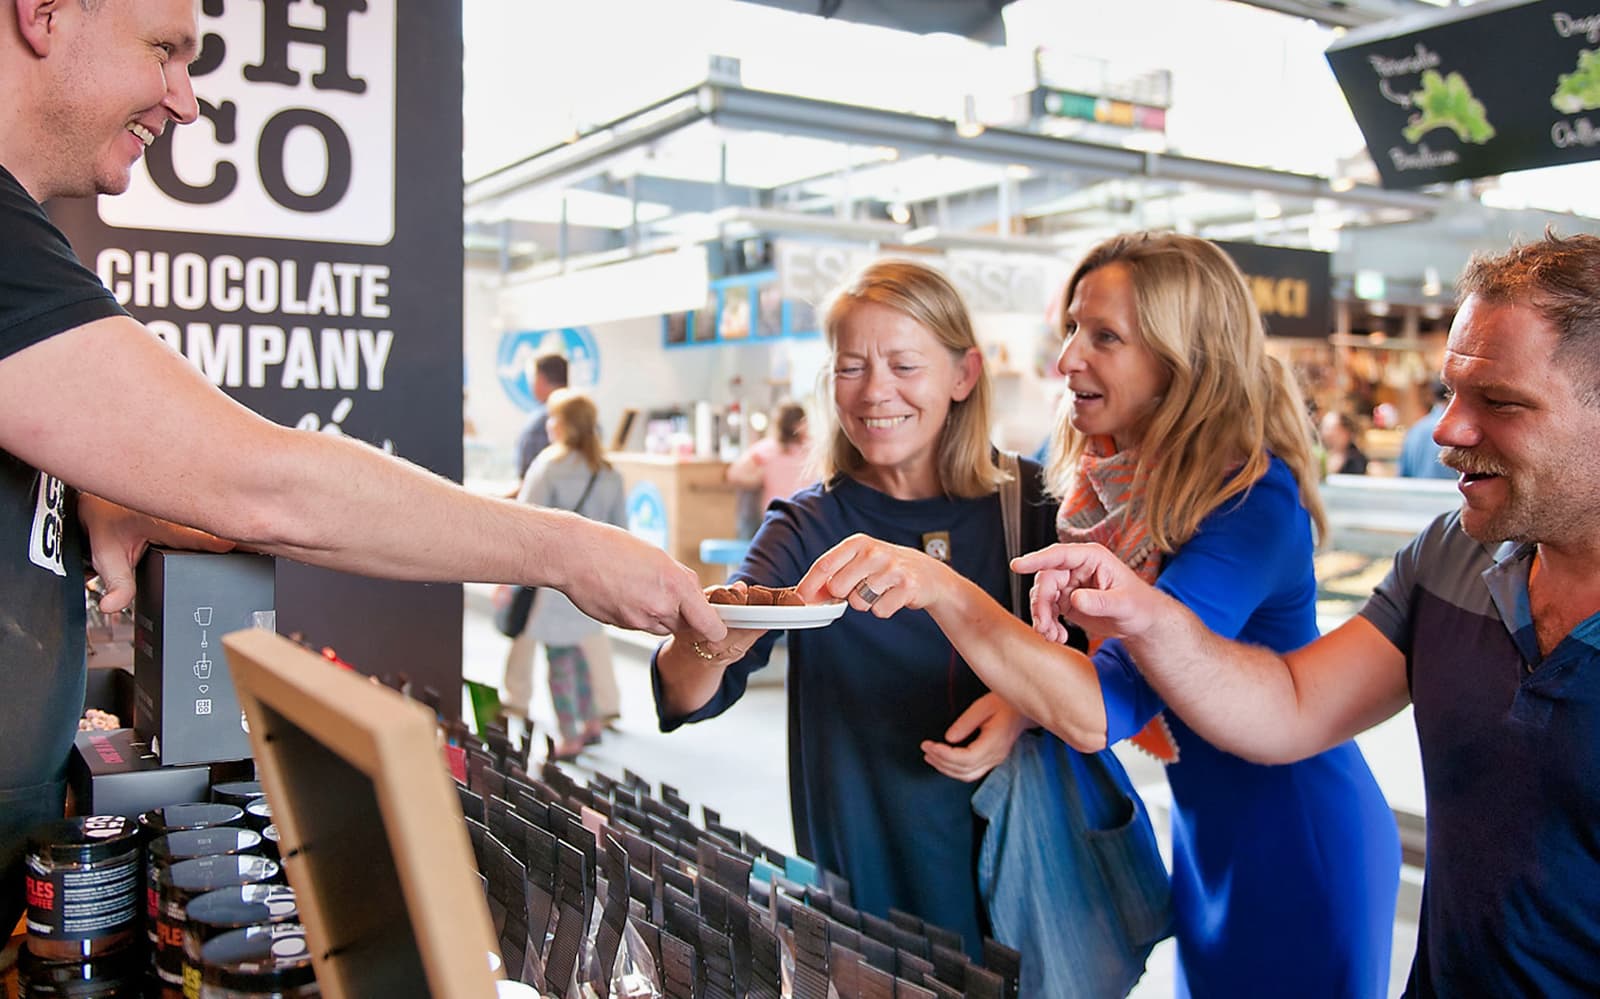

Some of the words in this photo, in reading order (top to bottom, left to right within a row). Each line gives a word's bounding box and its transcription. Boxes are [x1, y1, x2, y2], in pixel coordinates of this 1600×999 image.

[145, 97, 353, 214] CO
[97, 248, 391, 318] CHOCOLATE
[146, 319, 394, 391] MPANY
